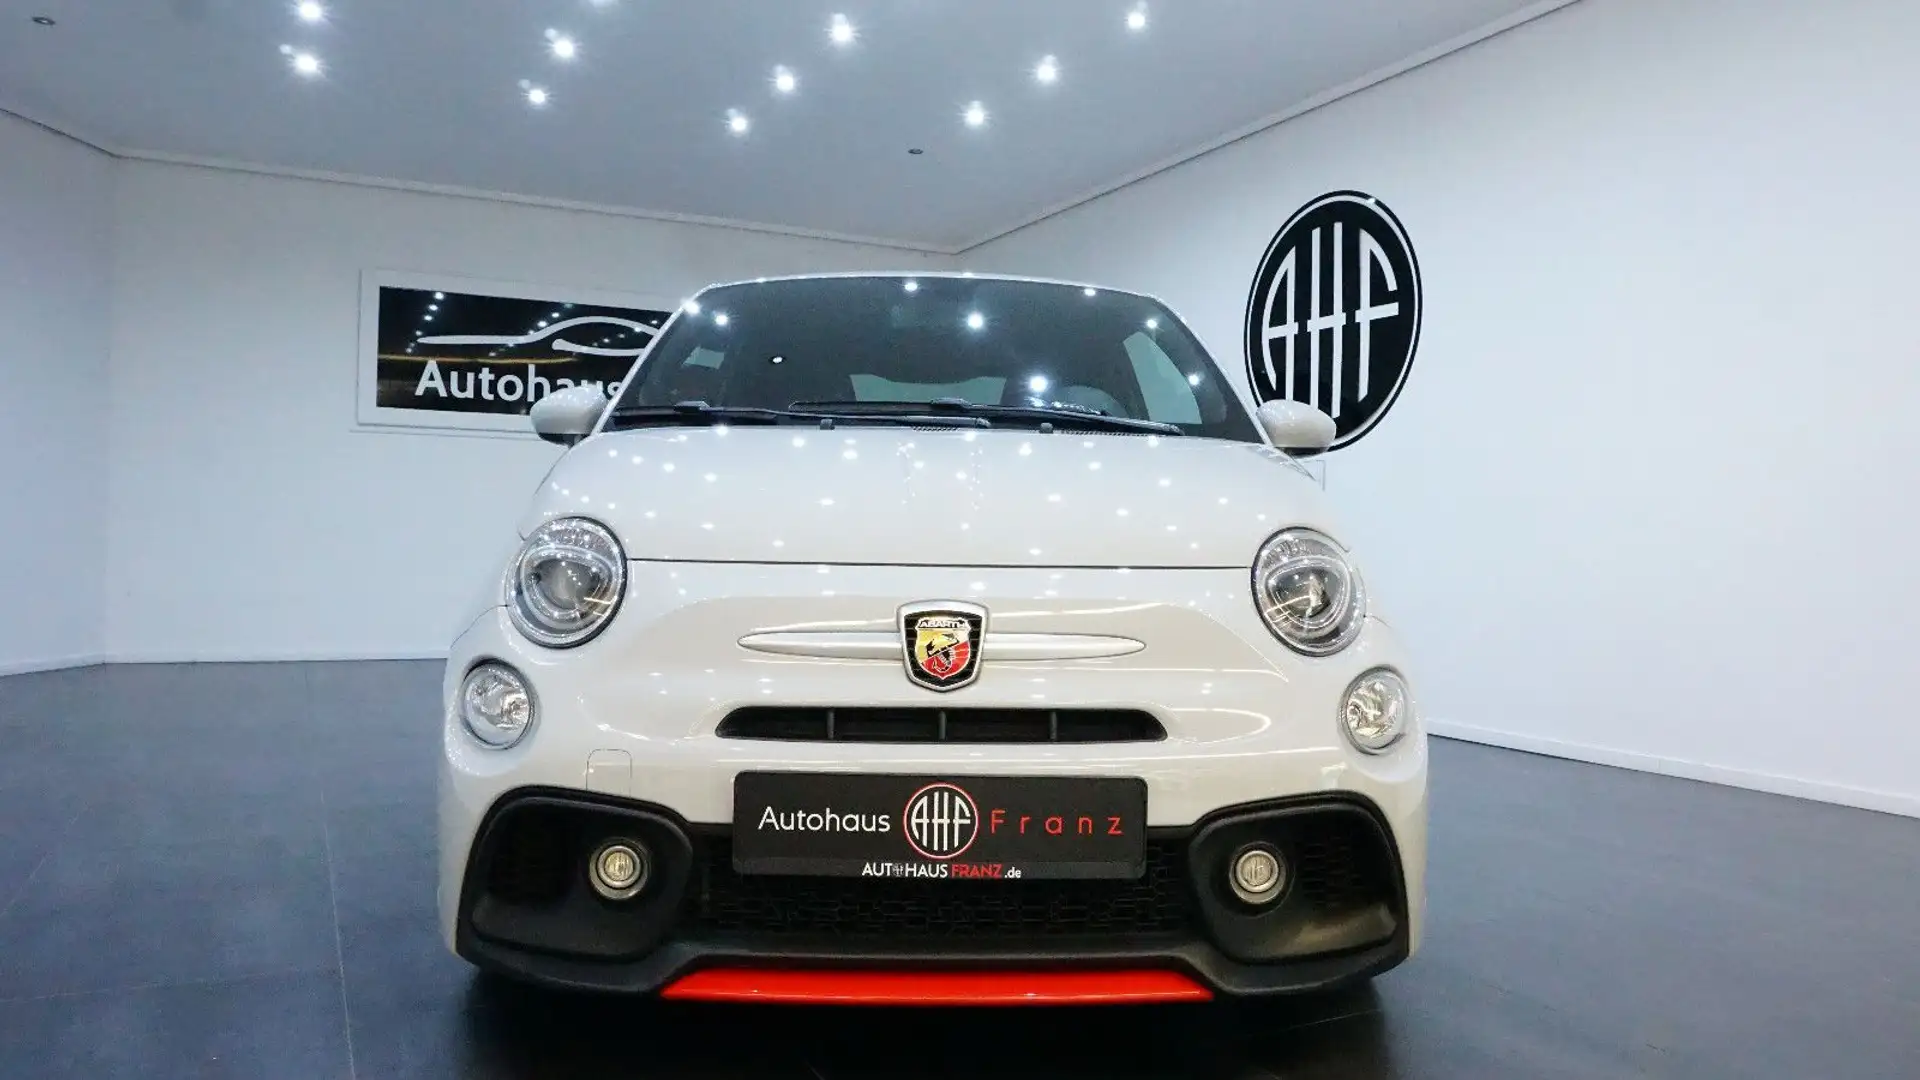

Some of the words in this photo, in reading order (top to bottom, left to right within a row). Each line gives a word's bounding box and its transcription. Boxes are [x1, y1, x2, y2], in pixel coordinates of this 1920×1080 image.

[1262, 222, 1399, 418] AHF
[415, 360, 624, 402] Autoh
[920, 620, 966, 628] ABARTH
[758, 806, 891, 832] Autohaus
[911, 791, 971, 852] AHF
[990, 808, 1123, 835] Franz
